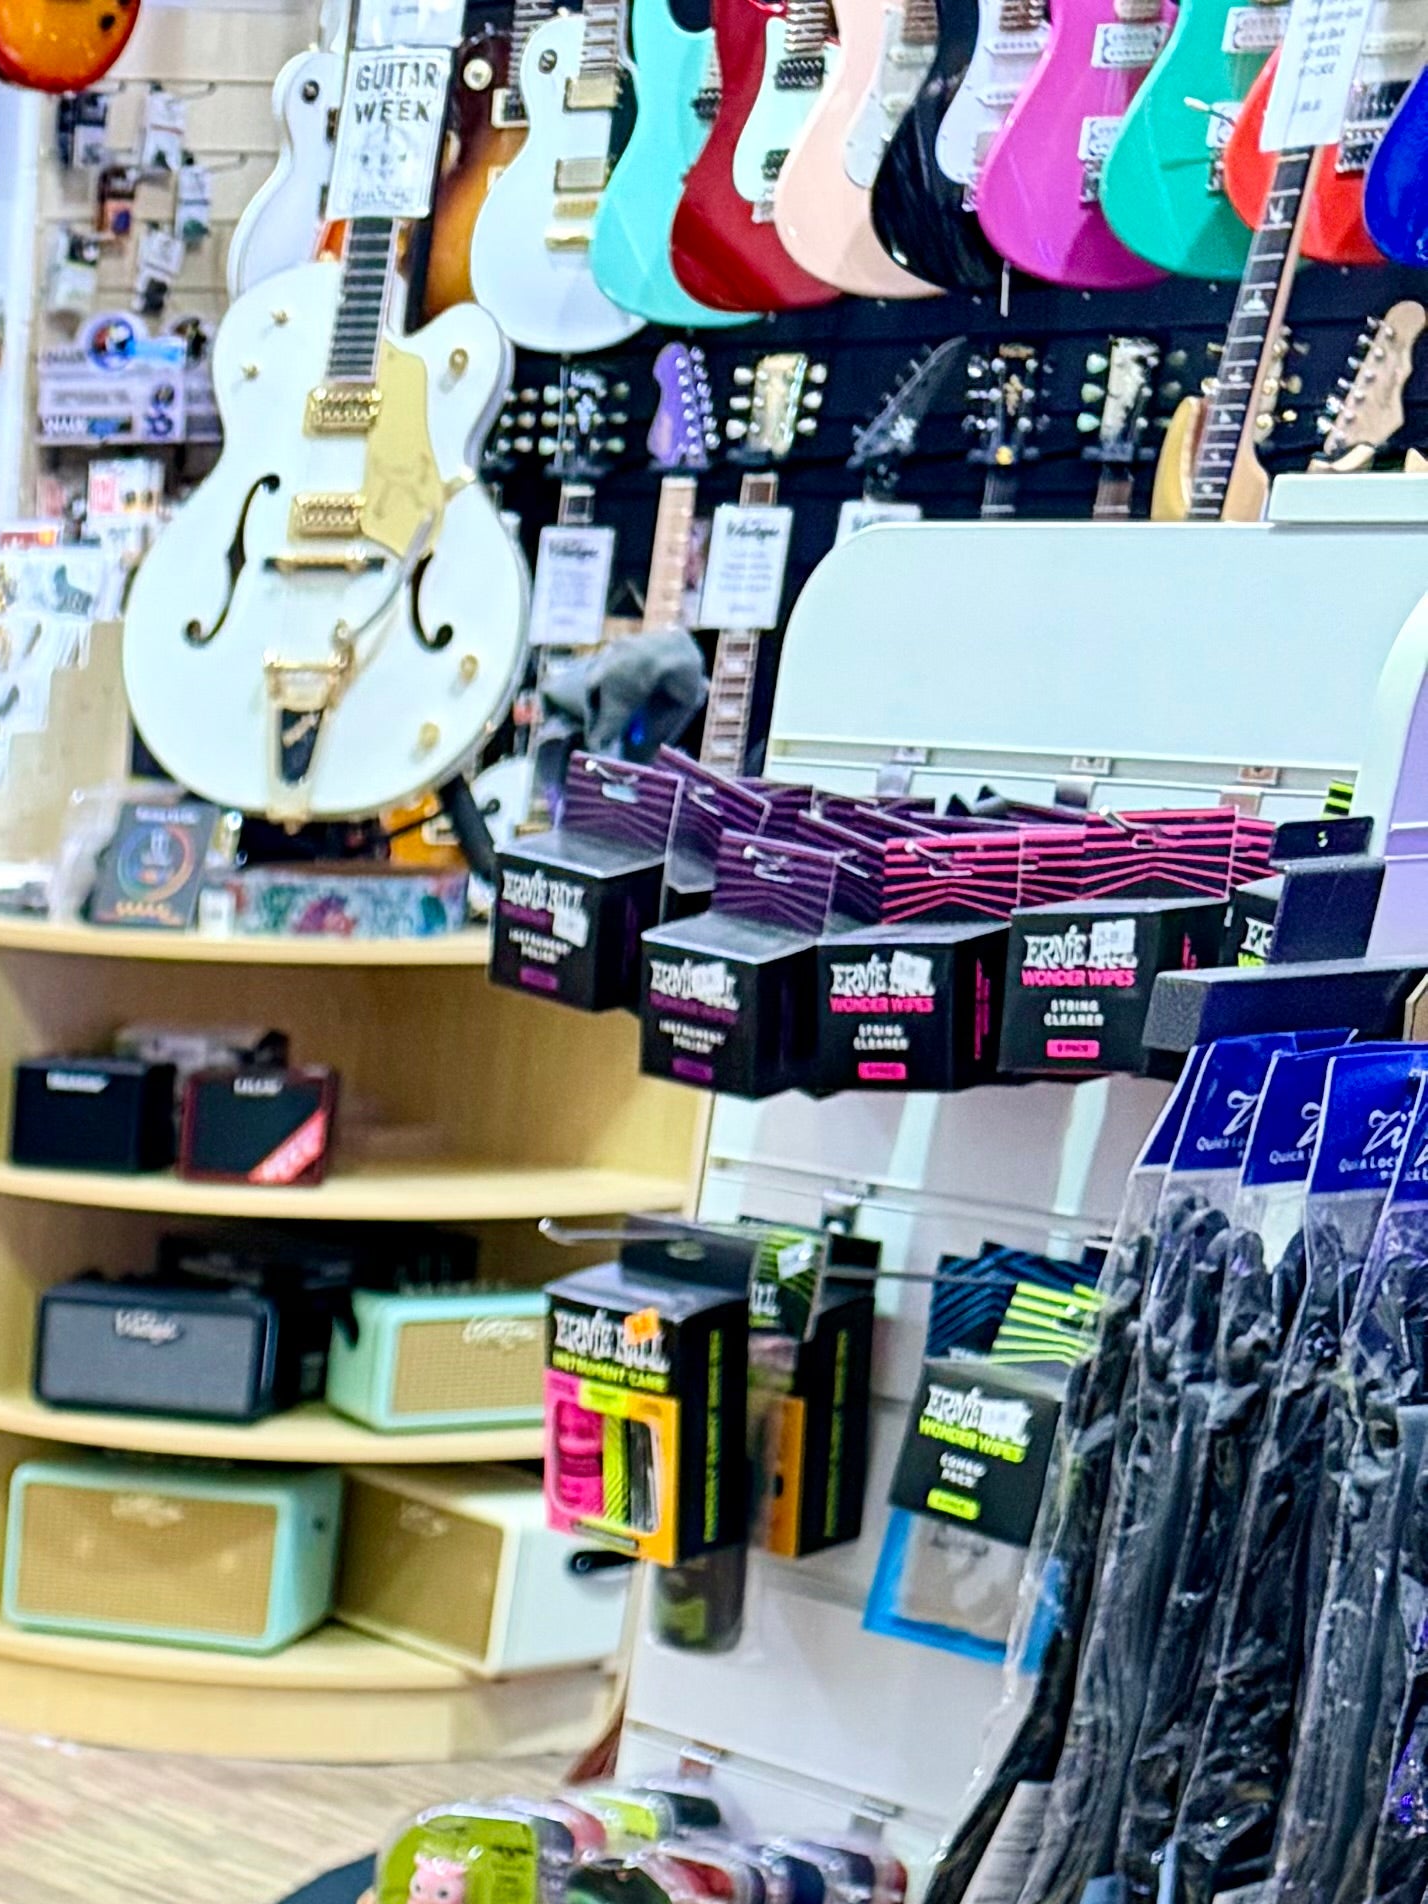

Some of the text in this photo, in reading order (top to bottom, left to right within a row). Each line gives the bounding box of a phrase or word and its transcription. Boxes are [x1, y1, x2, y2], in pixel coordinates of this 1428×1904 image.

[355, 61, 440, 91] GUITAR
[354, 99, 430, 124] WEEK
[1023, 925, 1086, 968] ERNIE
[830, 953, 887, 997] ERNIE
[1021, 968, 1136, 988] WONDER WIPES
[919, 1415, 978, 1450] WONDER
